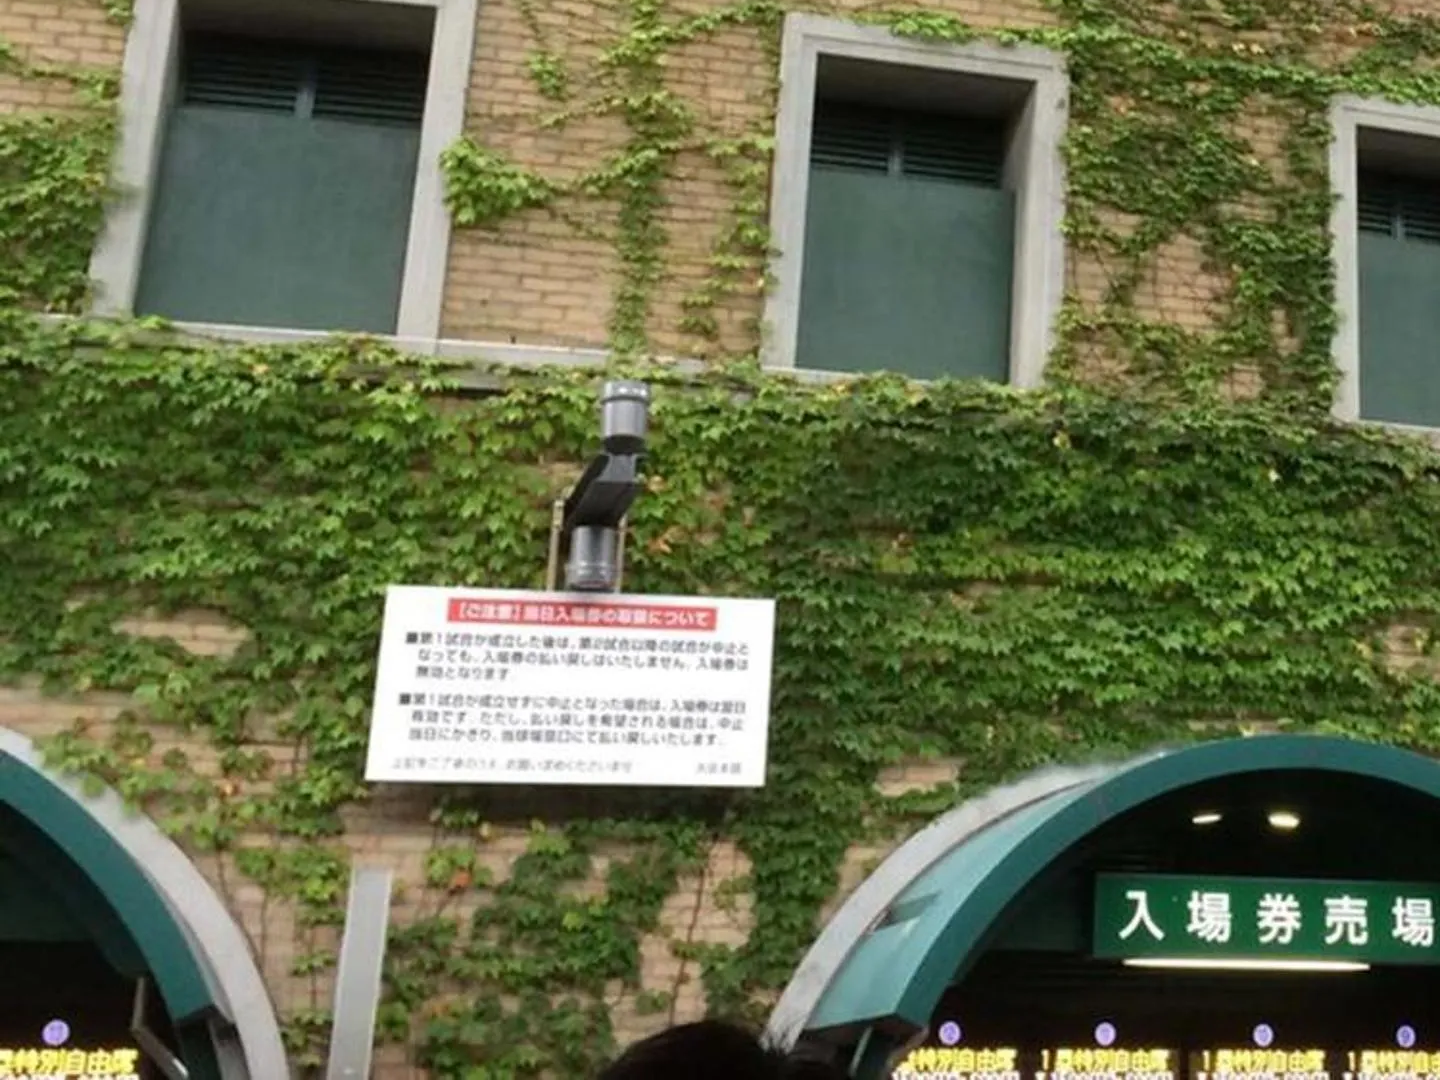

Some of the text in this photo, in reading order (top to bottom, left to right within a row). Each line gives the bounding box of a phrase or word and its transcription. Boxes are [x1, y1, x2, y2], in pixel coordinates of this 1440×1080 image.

[1118, 889, 1436, 948] 入場券売場
